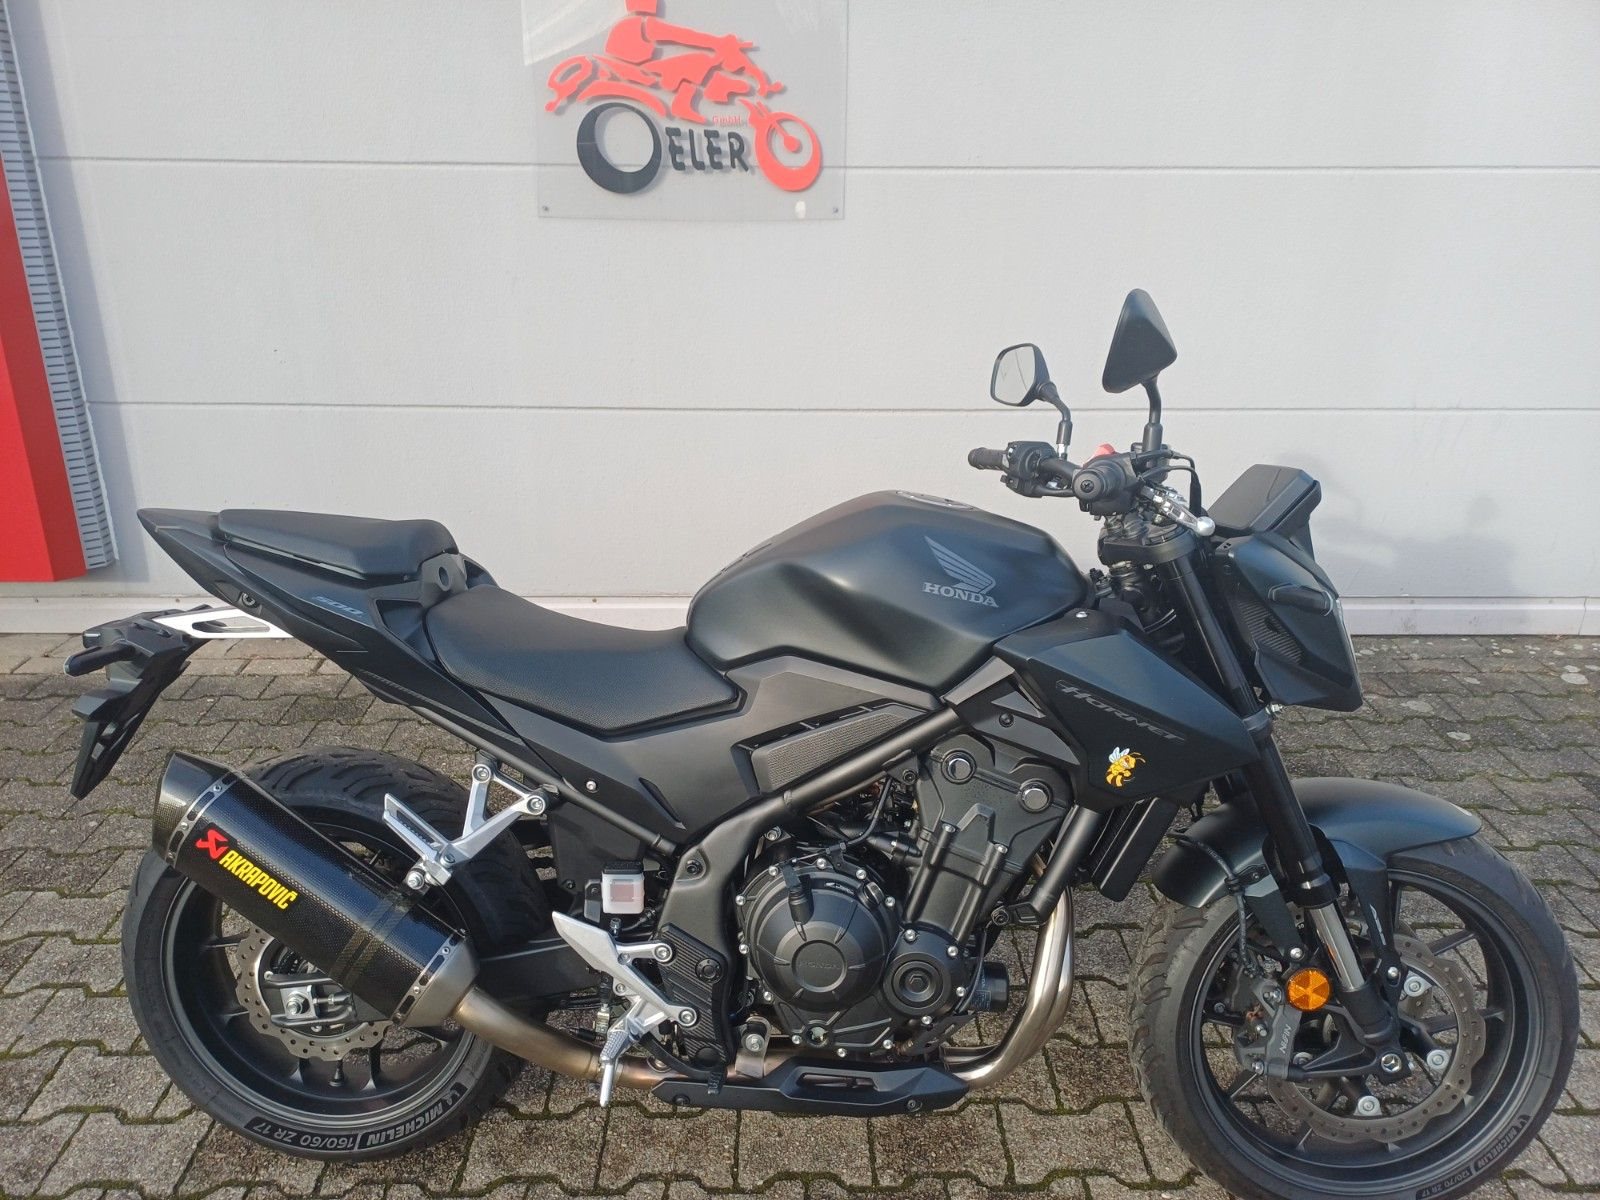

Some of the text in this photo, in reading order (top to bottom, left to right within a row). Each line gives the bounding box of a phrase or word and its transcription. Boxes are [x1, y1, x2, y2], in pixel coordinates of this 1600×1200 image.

[922, 582, 999, 608] HONDA
[1056, 680, 1185, 742] HORNET
[252, 1102, 443, 1149] MICHELIN 160/60 ZR 17
[1476, 1128, 1518, 1169] MICHELIN
